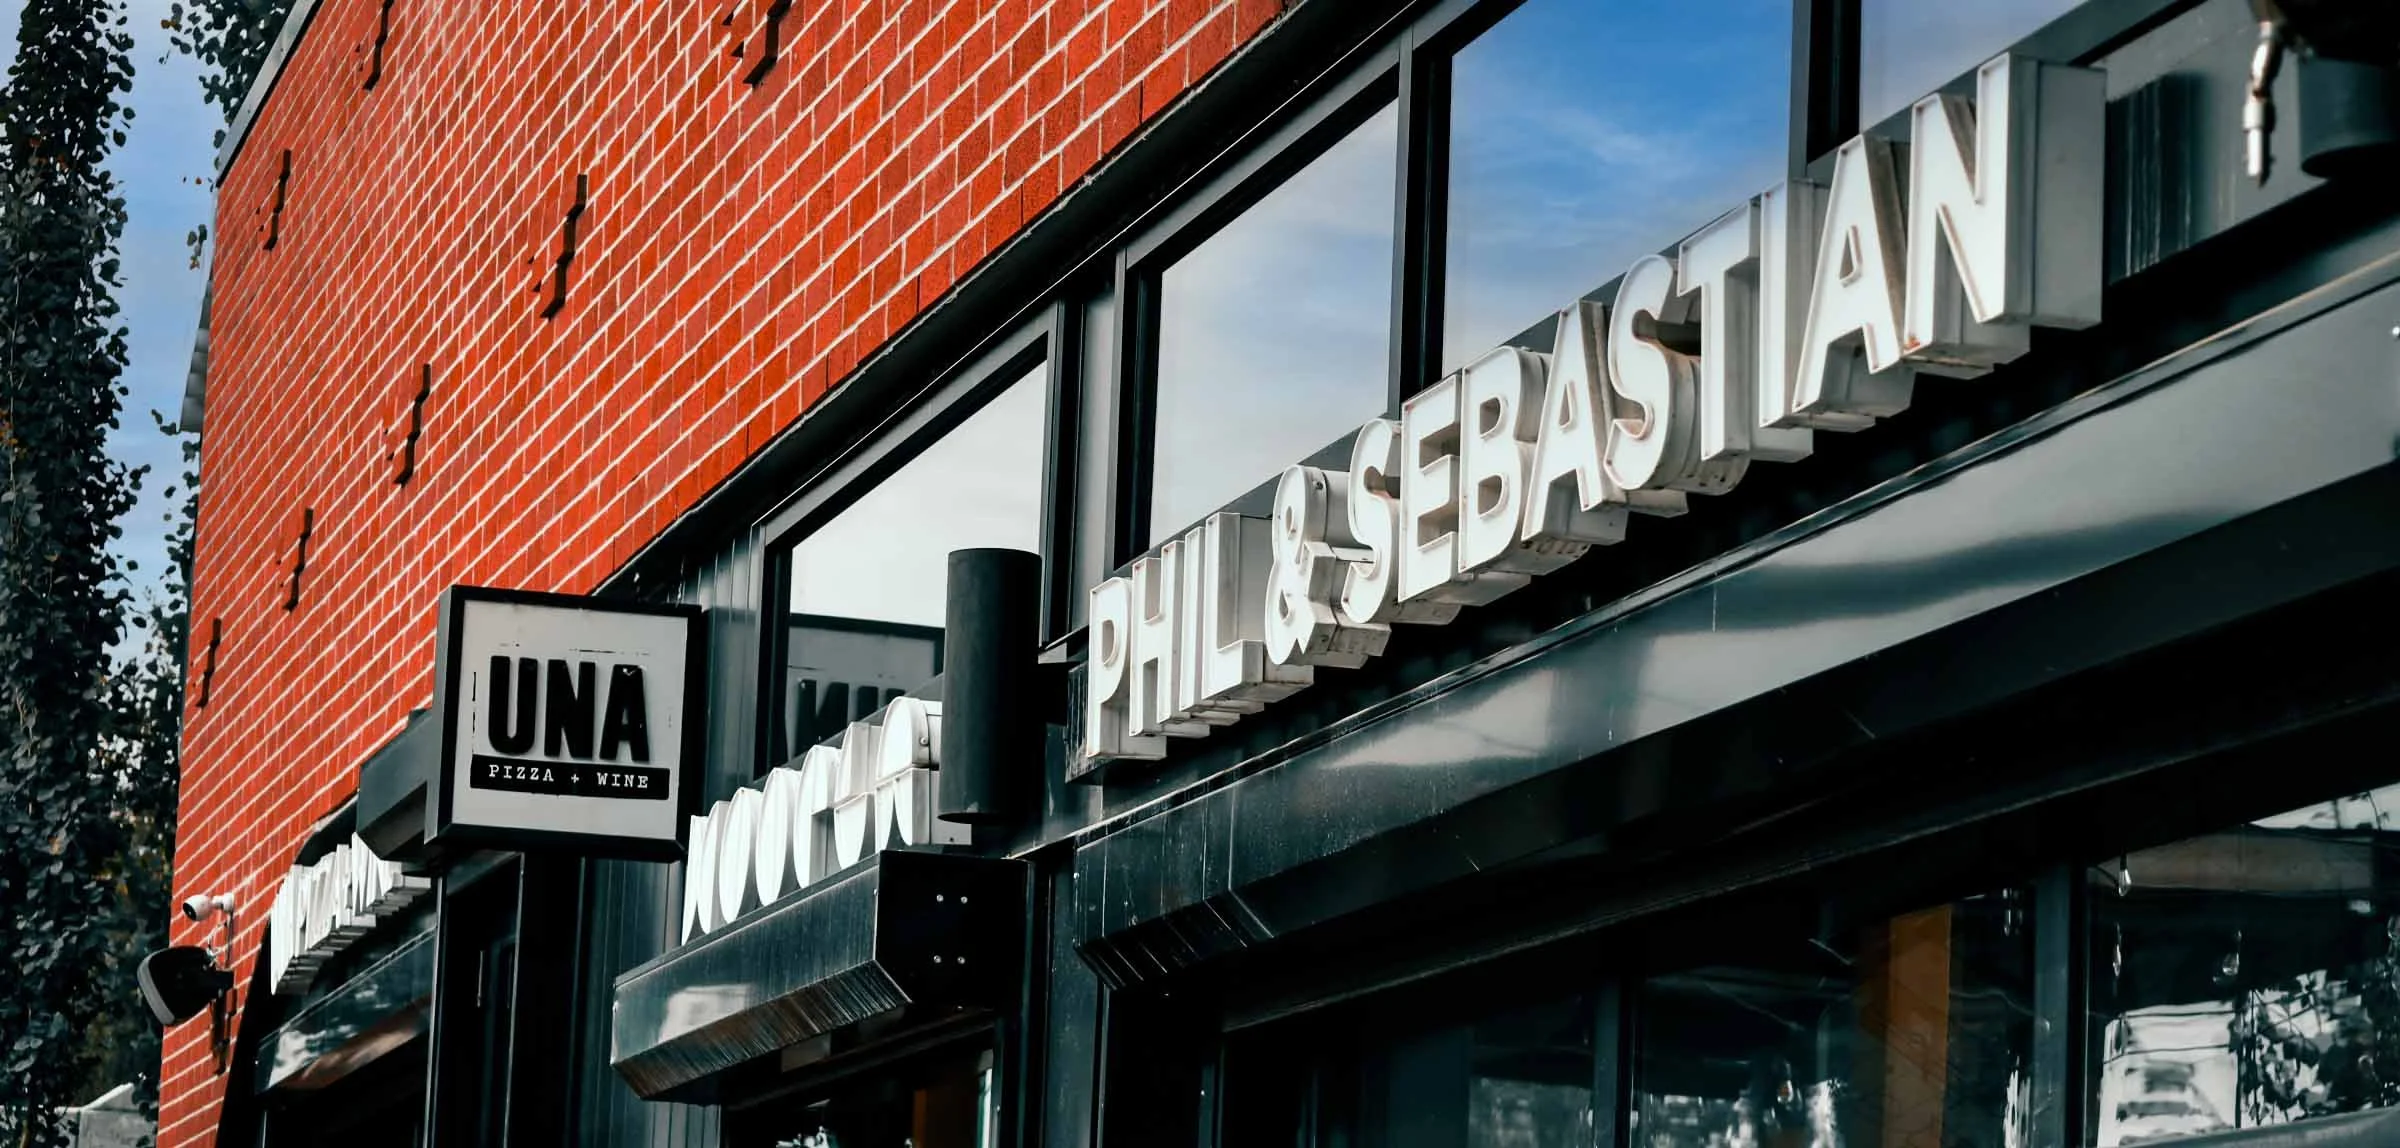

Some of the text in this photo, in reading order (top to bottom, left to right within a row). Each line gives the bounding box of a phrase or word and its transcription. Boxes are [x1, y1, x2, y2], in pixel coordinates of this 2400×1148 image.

[1087, 52, 2012, 759] PHIL & SEBASTIAN
[488, 655, 650, 763] UNA
[488, 764, 649, 789] PIZZA + WINE
